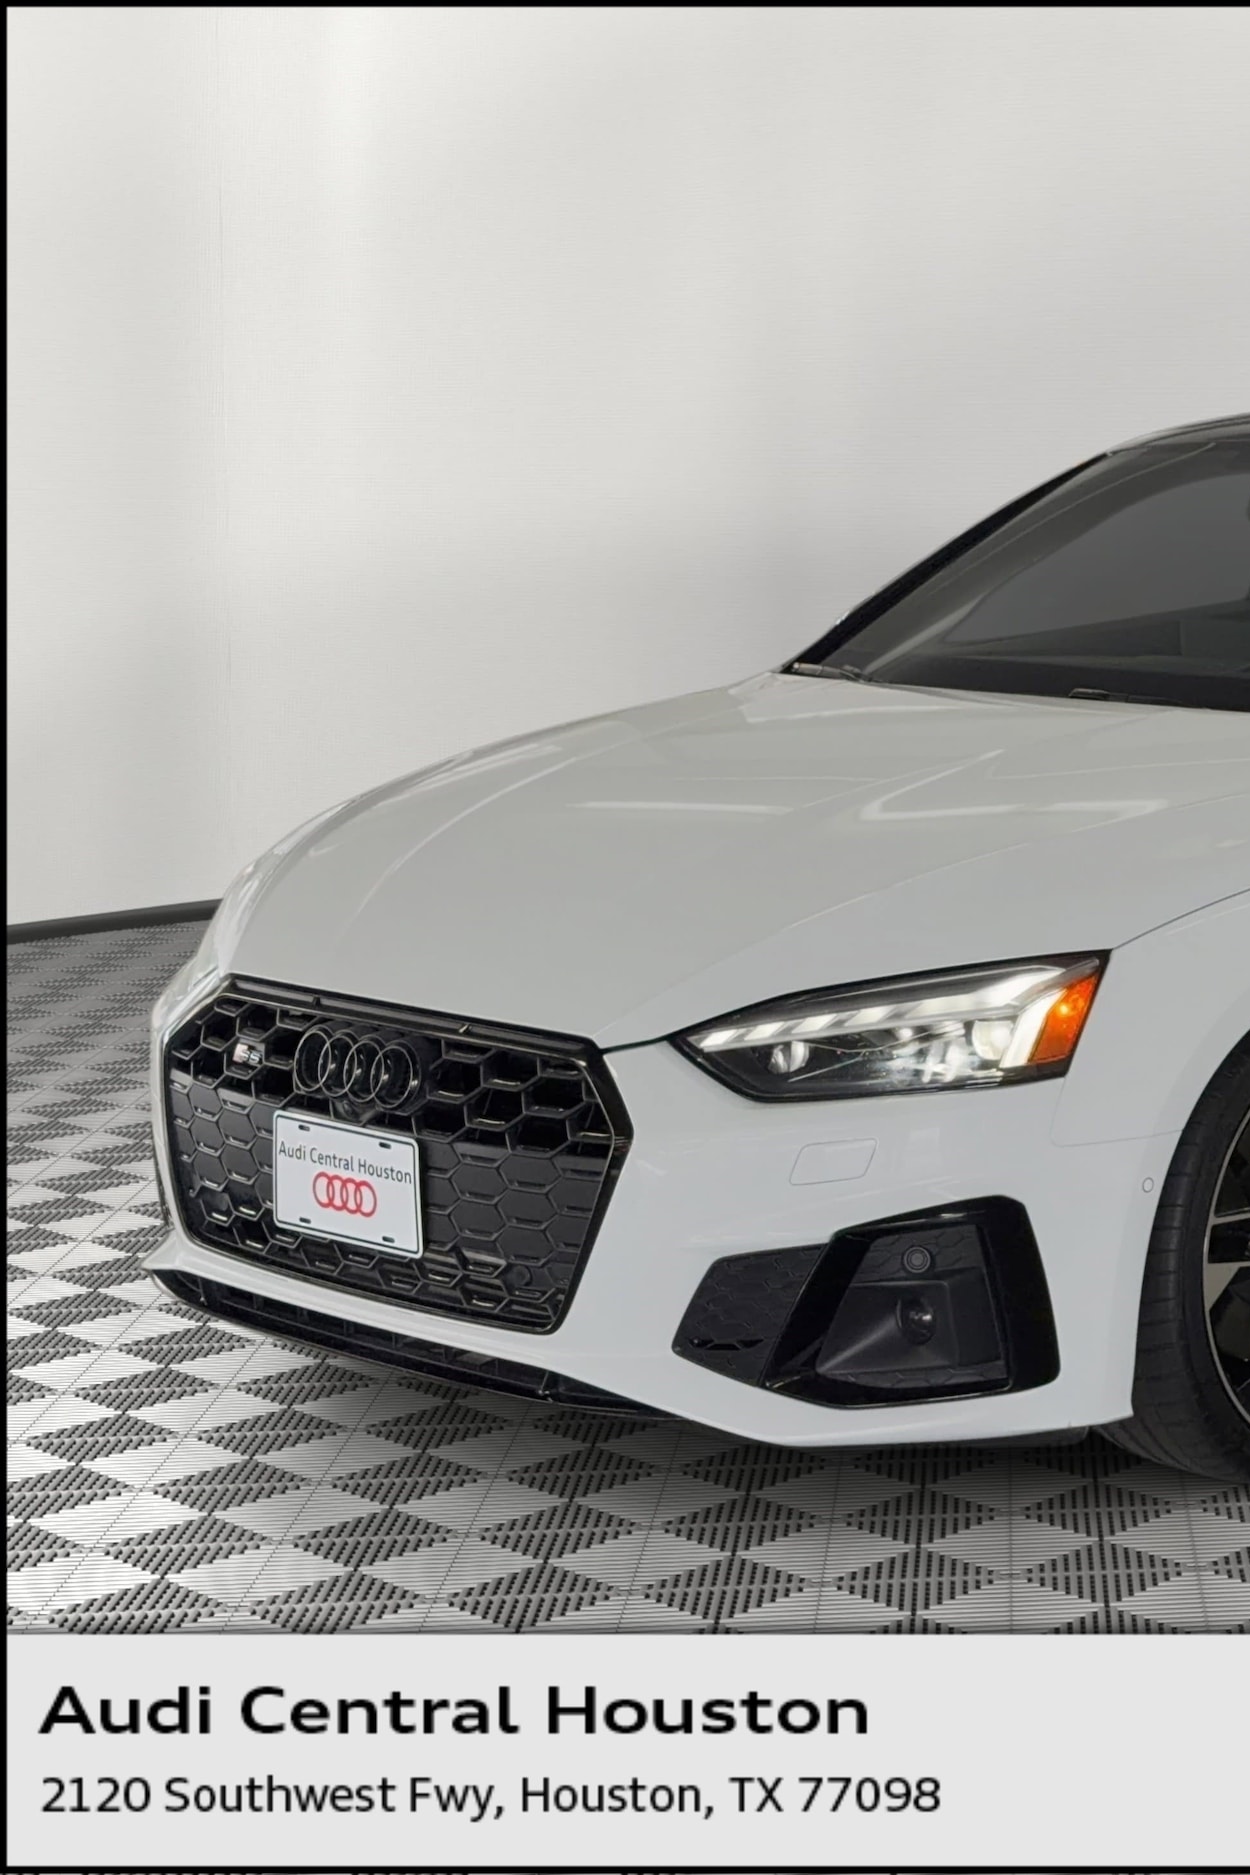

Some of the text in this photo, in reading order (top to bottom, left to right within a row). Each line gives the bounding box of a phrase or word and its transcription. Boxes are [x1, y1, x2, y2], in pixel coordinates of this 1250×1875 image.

[279, 1141, 412, 1184] Audi Central Houston
